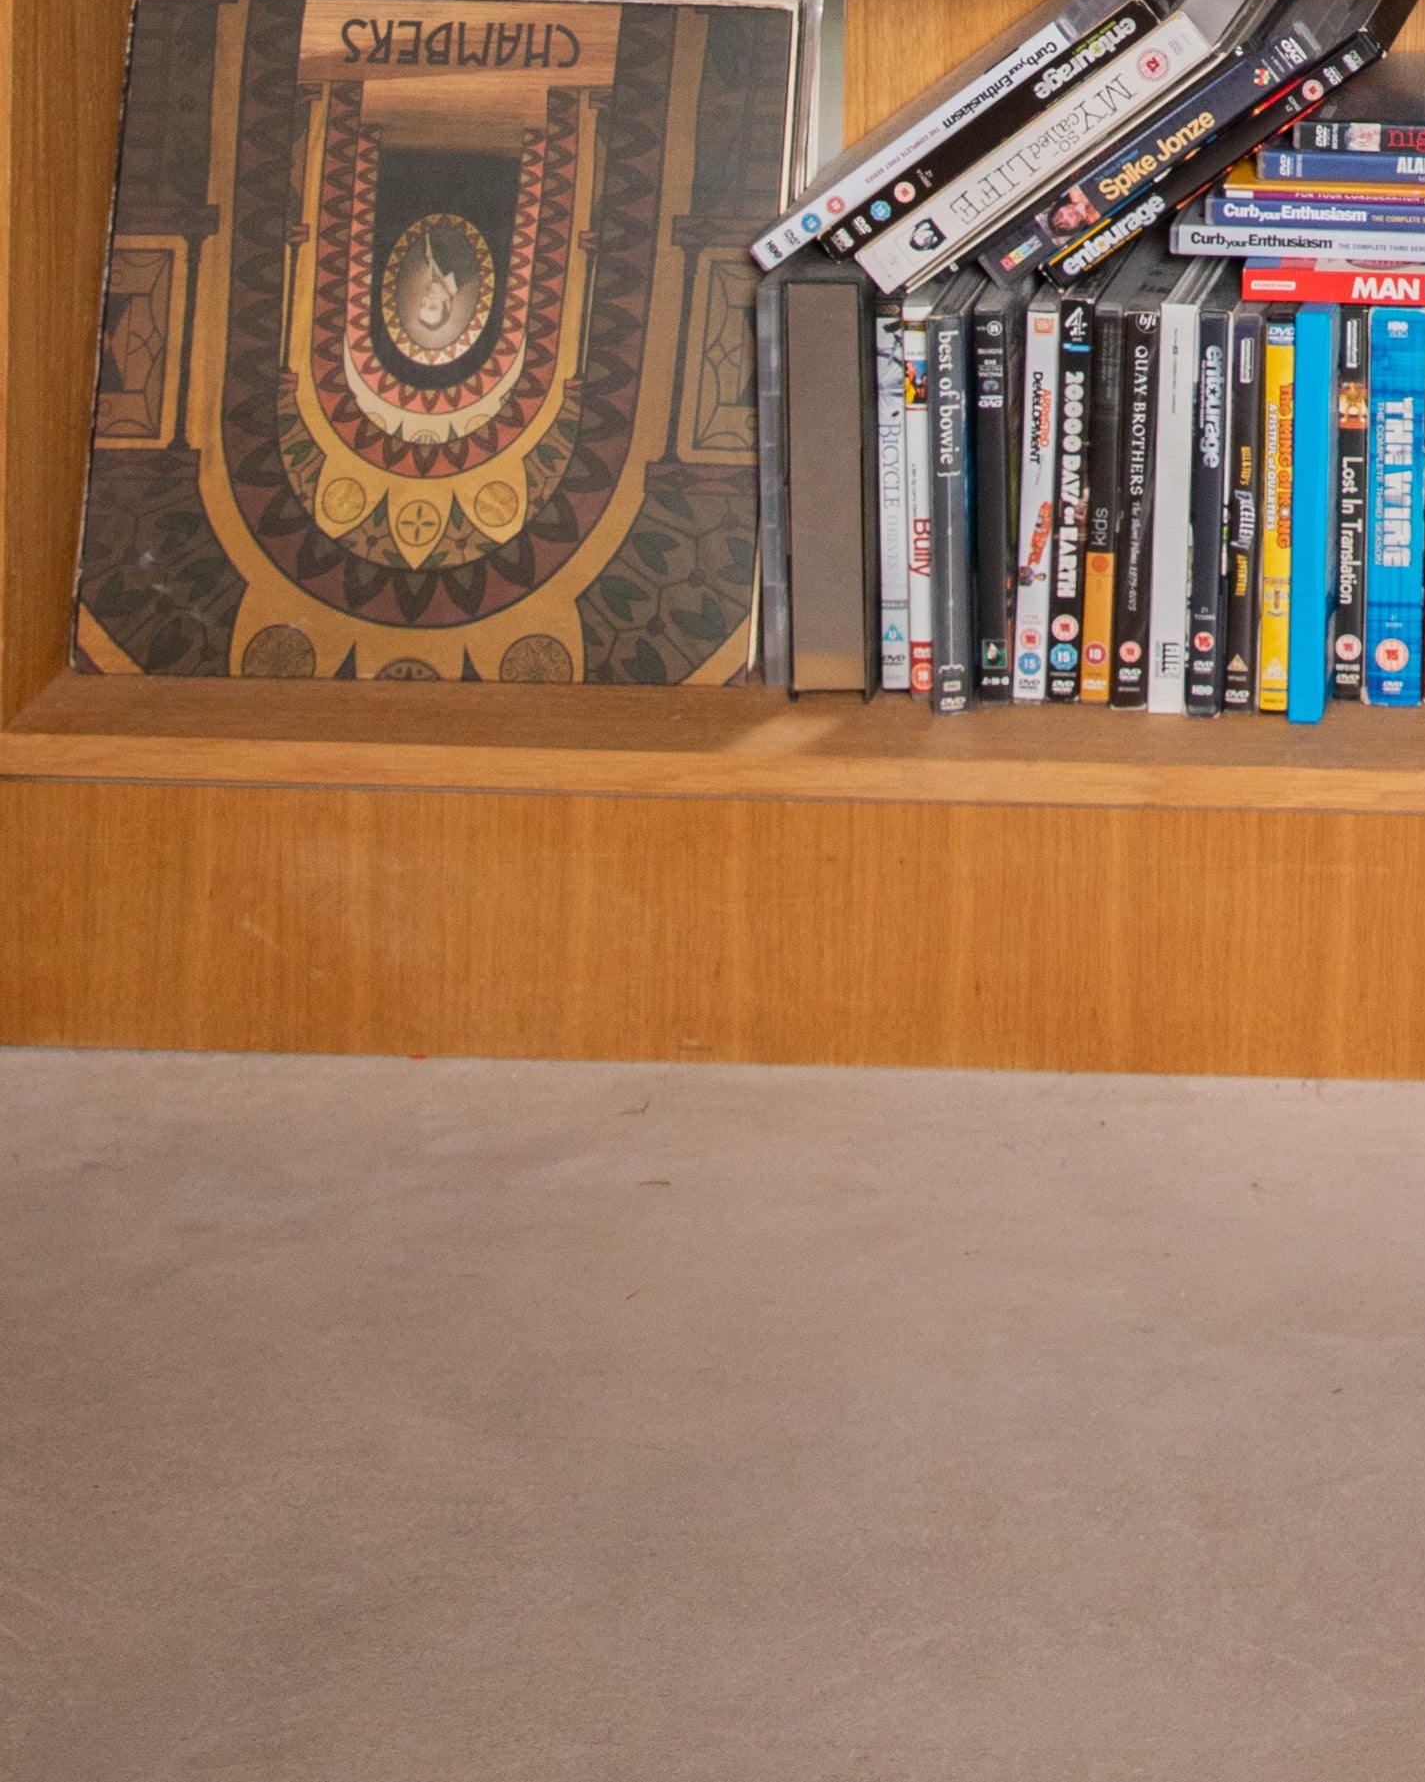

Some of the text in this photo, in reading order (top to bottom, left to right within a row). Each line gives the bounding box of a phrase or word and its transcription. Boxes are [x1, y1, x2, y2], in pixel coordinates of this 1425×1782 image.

[341, 18, 580, 68] CHAMBERS
[1099, 110, 1217, 202] Spike Jonze
[1352, 277, 1411, 301] MAN
[938, 330, 961, 465] best of bowie
[1340, 457, 1363, 604] Lost In Translation
